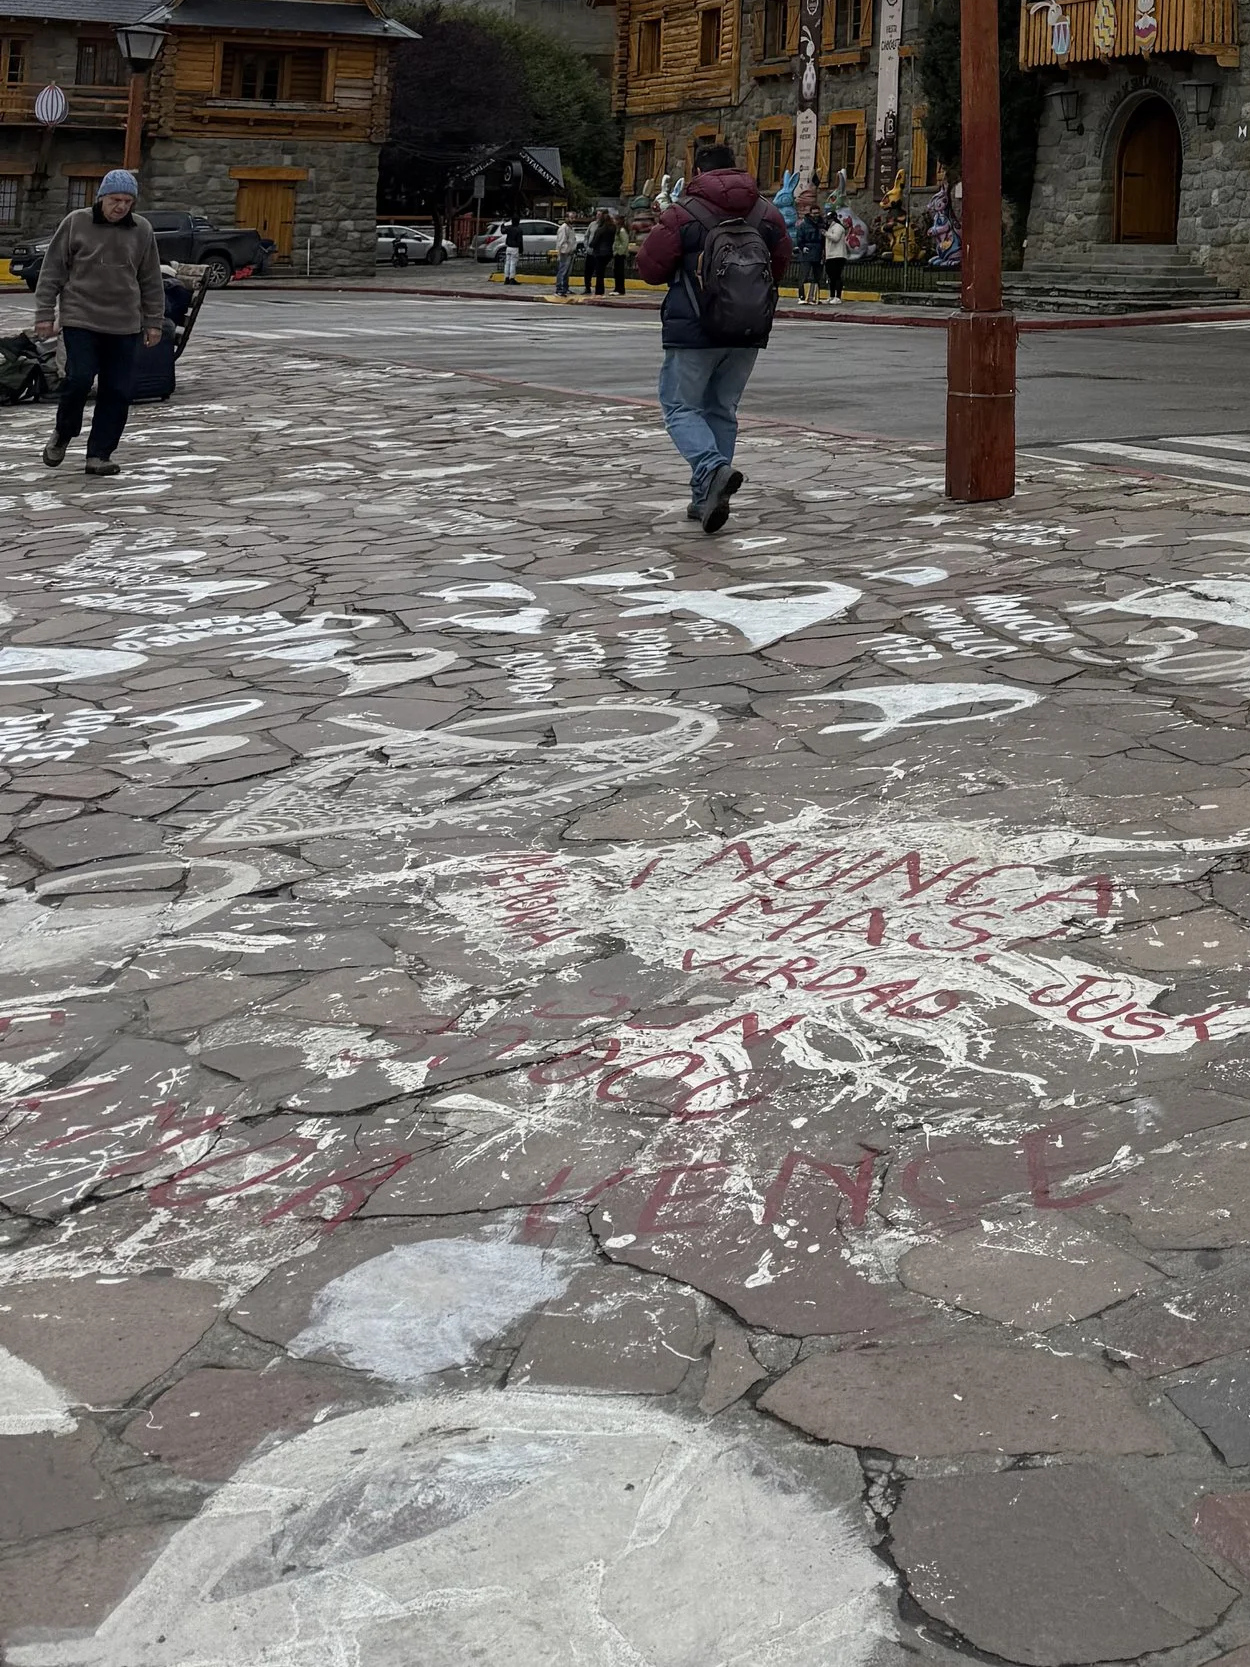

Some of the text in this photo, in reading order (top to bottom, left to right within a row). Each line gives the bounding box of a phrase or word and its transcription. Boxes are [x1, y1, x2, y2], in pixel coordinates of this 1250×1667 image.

[617, 626, 677, 679] BORDON
[857, 633, 943, 663] 1977
[495, 651, 566, 704] BORDON
[8, 705, 132, 764] JORGE
[682, 946, 962, 1021] VERDAD
